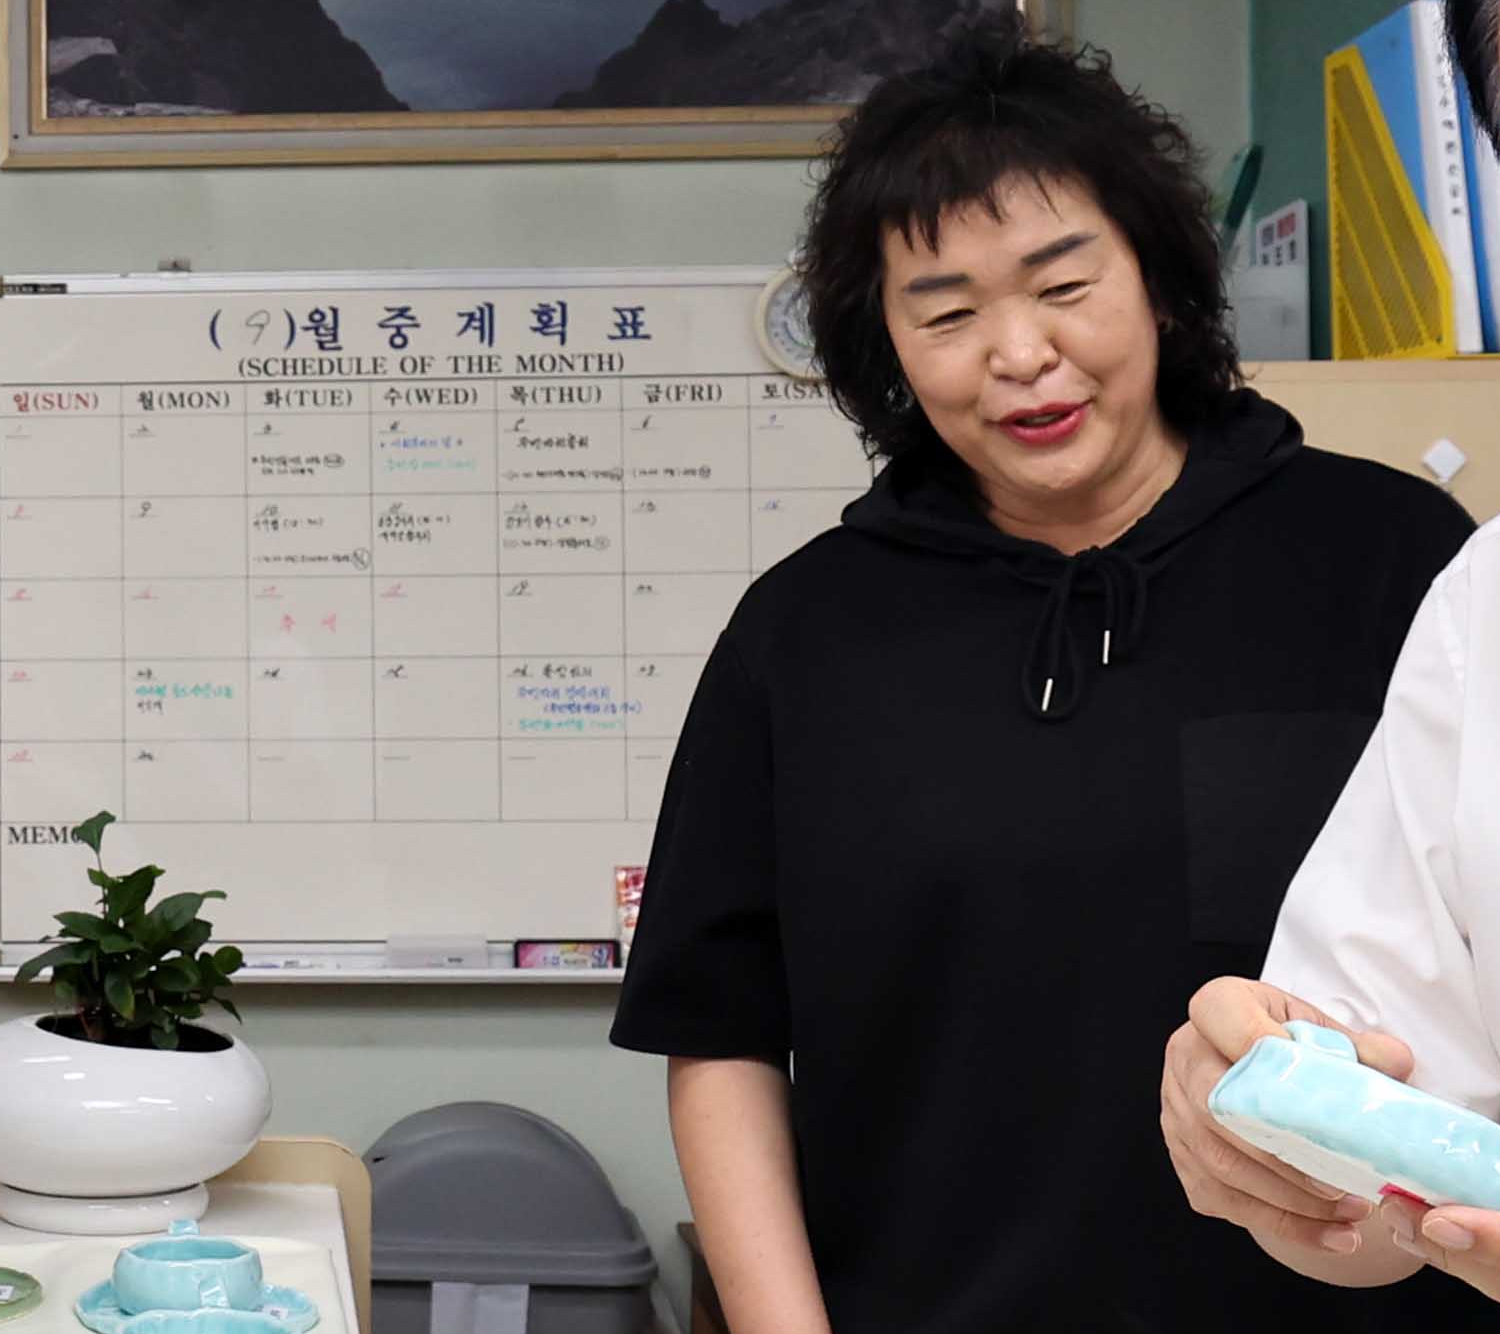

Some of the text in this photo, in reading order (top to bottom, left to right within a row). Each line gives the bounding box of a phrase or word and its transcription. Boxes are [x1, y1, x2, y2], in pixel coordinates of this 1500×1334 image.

[237, 352, 625, 379] (SCHEDULE OF THE MONTH)
[12, 390, 99, 412] 일(SUN)
[137, 388, 231, 411] 월(MON)
[263, 386, 353, 408] 화(TUE)
[383, 386, 479, 407] 수(WED)
[509, 384, 603, 407] 목(THU)
[642, 382, 723, 405] 금(FRI)
